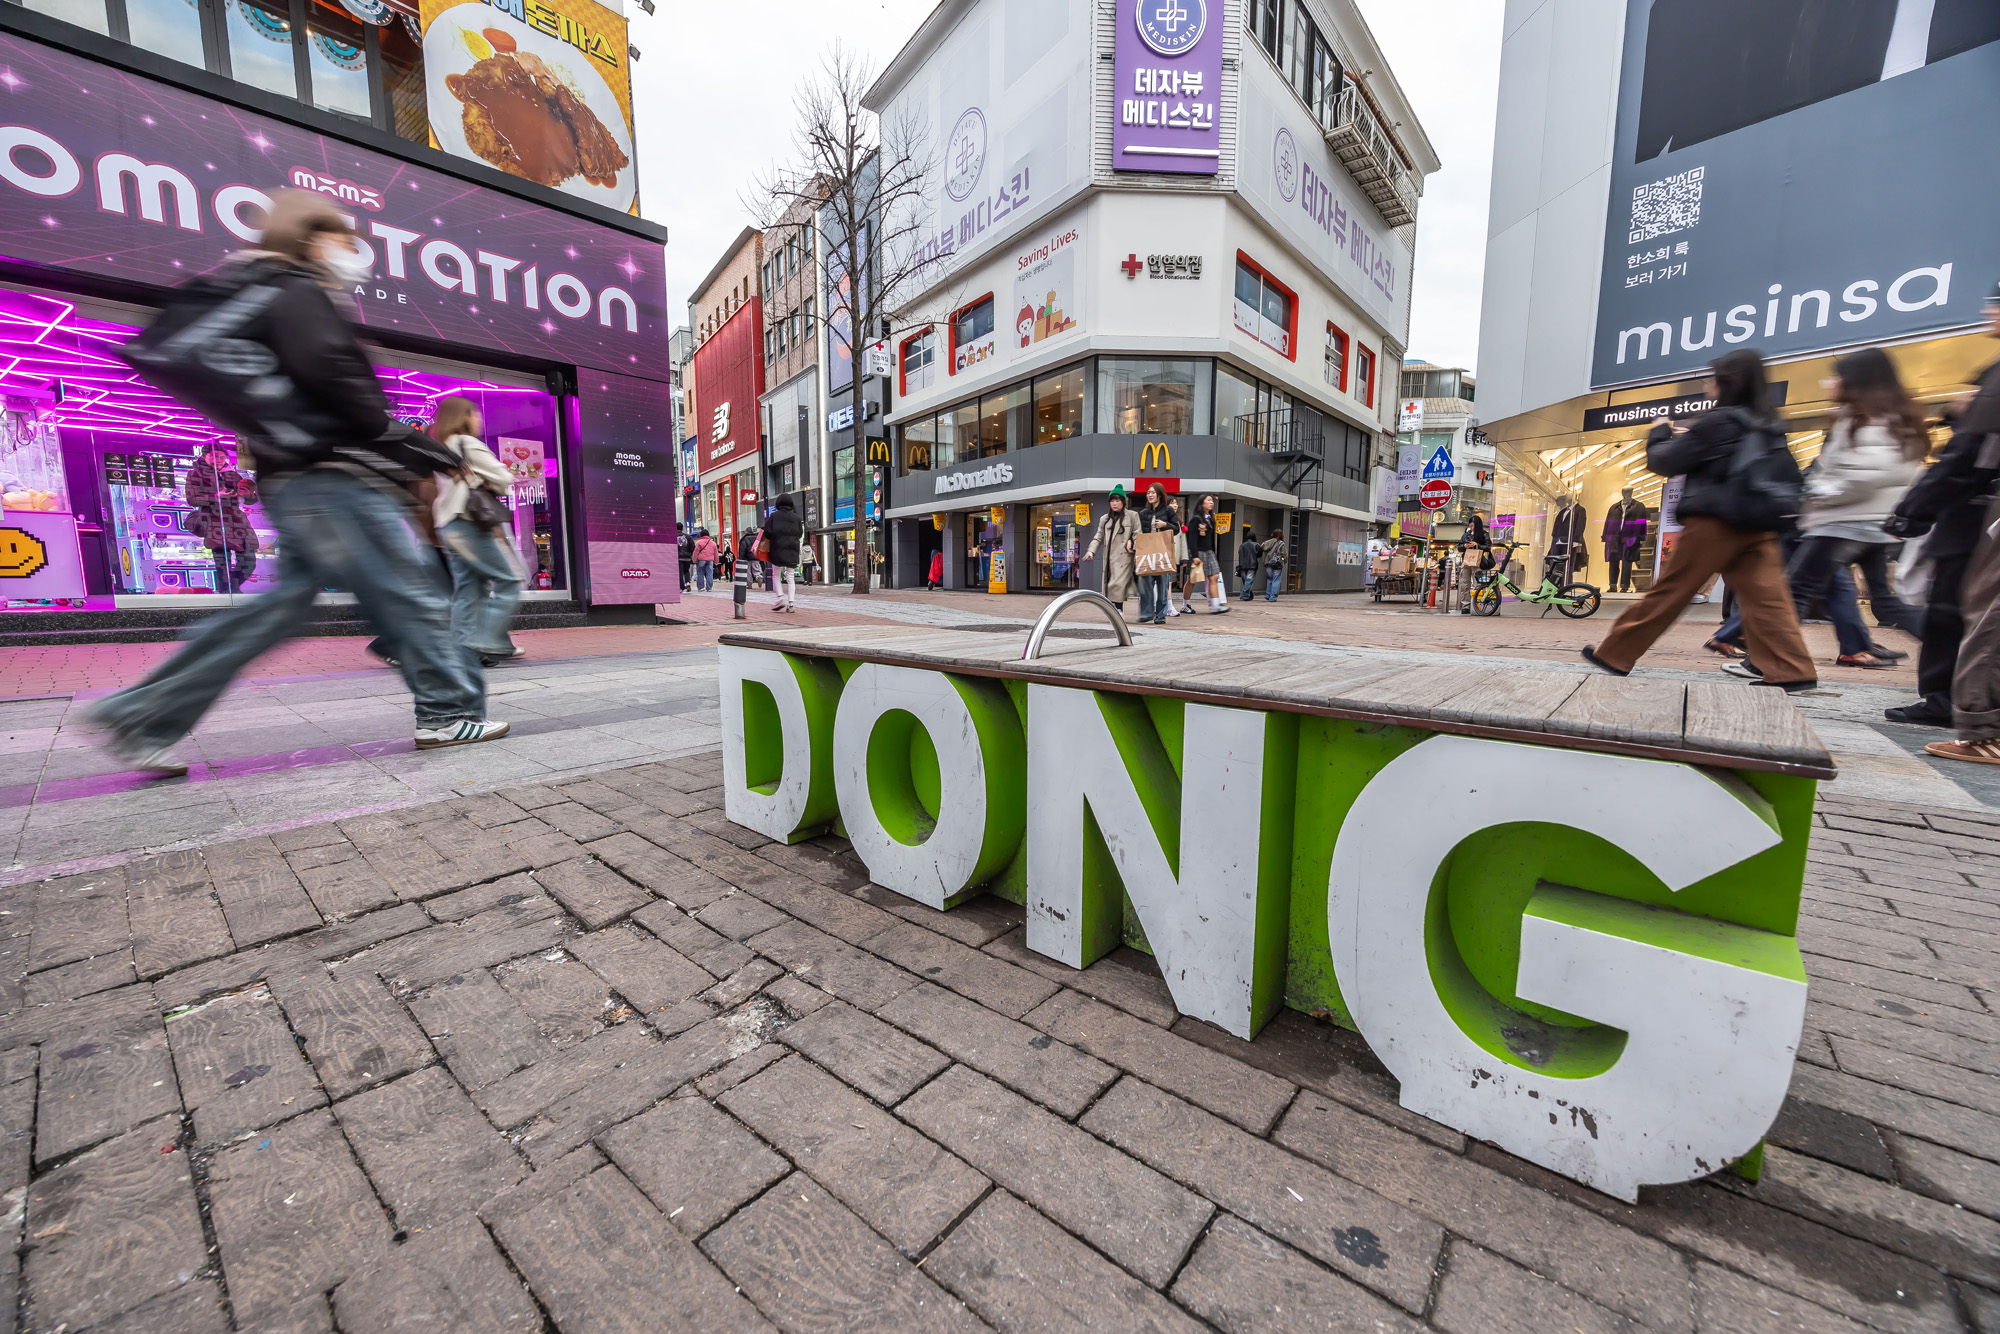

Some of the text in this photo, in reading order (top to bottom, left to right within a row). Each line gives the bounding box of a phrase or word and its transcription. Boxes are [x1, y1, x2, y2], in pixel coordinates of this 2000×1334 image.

[1145, 21, 1198, 46] MEDISKIN
[1135, 68, 1204, 97] 데자뷰
[1122, 99, 1213, 130] 메디스킨
[950, 154, 981, 192] MEDISKIN
[960, 166, 1030, 246] 메디스킨
[1302, 161, 1395, 303] 데자뷰 메디스킨
[1018, 229, 1079, 271] Saving Lives,
[1627, 241, 1690, 269] 한소희 룩
[1624, 261, 1688, 289] 보러 가기
[1616, 262, 1953, 364] musinsa
[1604, 405, 1670, 423] musinsa
[718, 440, 736, 457] balance
[934, 462, 1013, 495] McDonald's
[1135, 551, 1173, 574] ZARA
[720, 641, 1808, 1204] DONG
